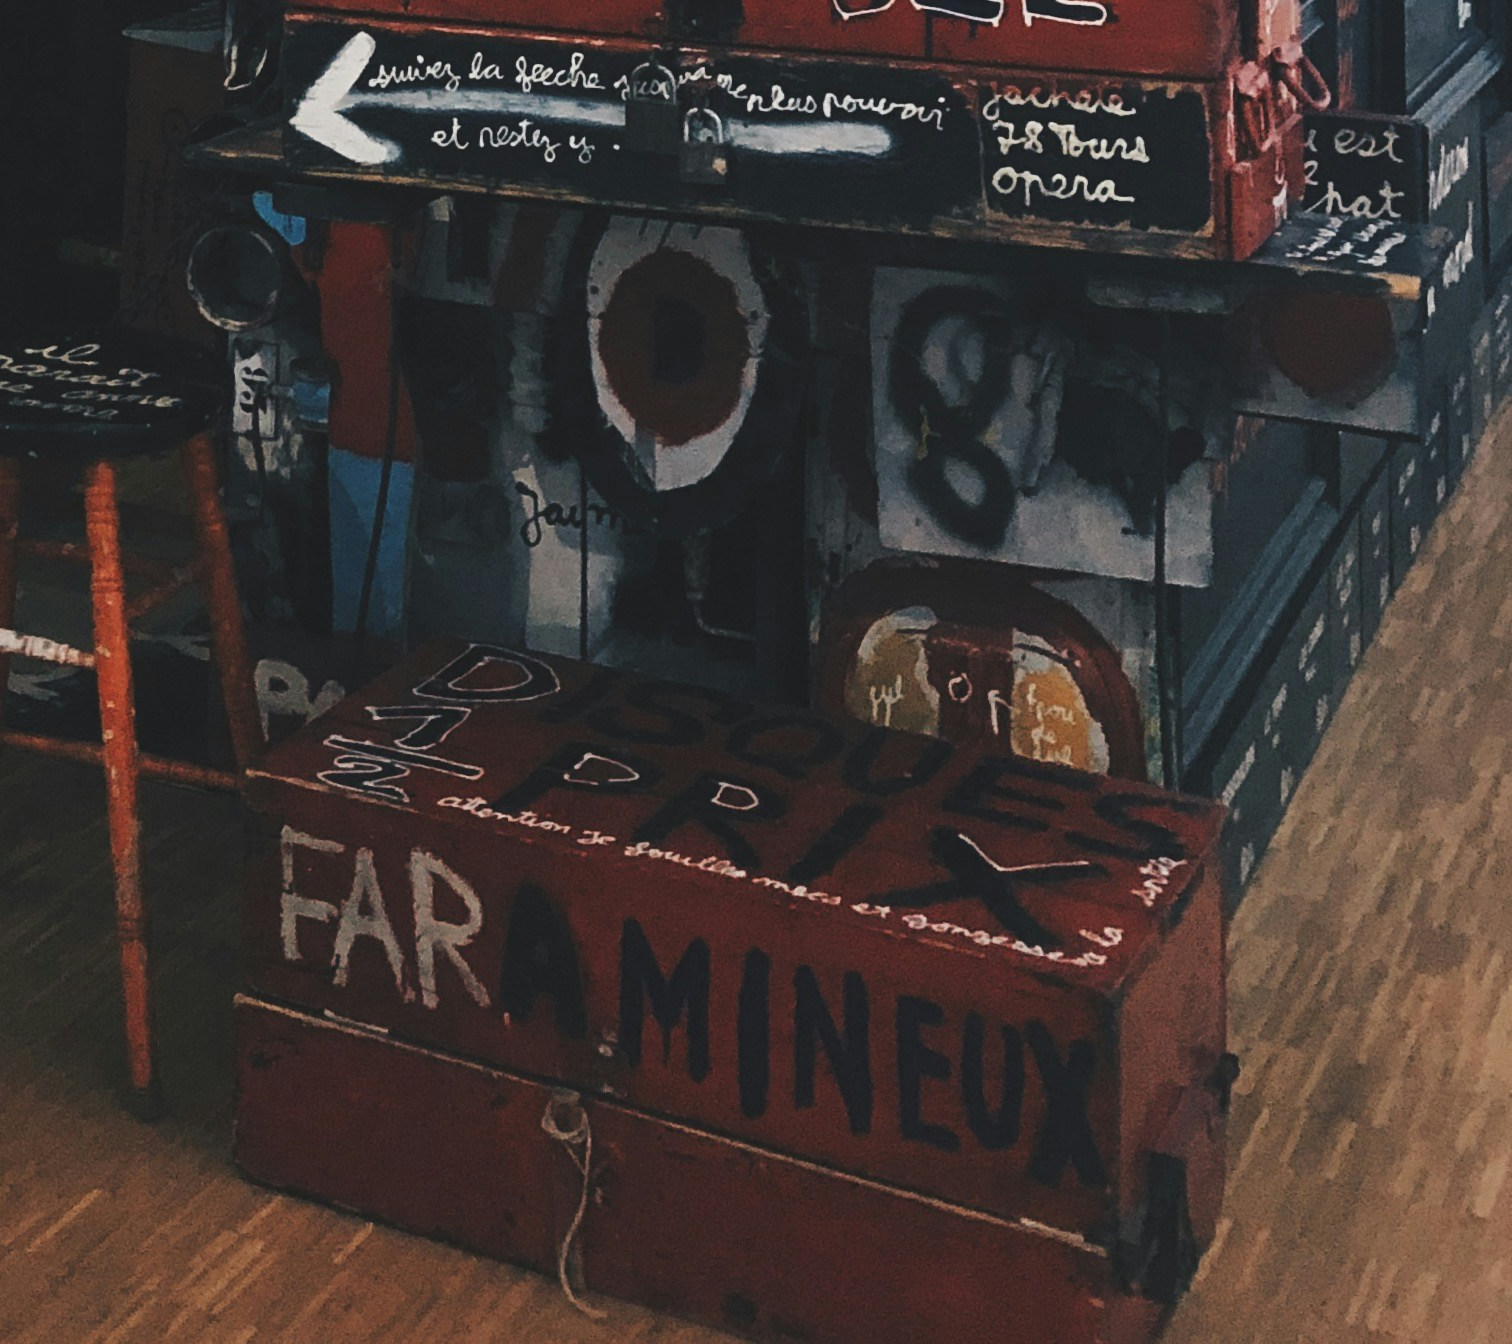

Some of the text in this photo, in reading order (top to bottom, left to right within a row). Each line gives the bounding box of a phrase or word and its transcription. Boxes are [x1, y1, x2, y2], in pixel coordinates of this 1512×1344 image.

[368, 54, 462, 92] suivez
[468, 51, 505, 81] la
[431, 117, 563, 163] et restez
[991, 118, 1045, 156] 78
[990, 165, 1136, 208] opera
[278, 820, 1112, 1194] FARAMINEUX
